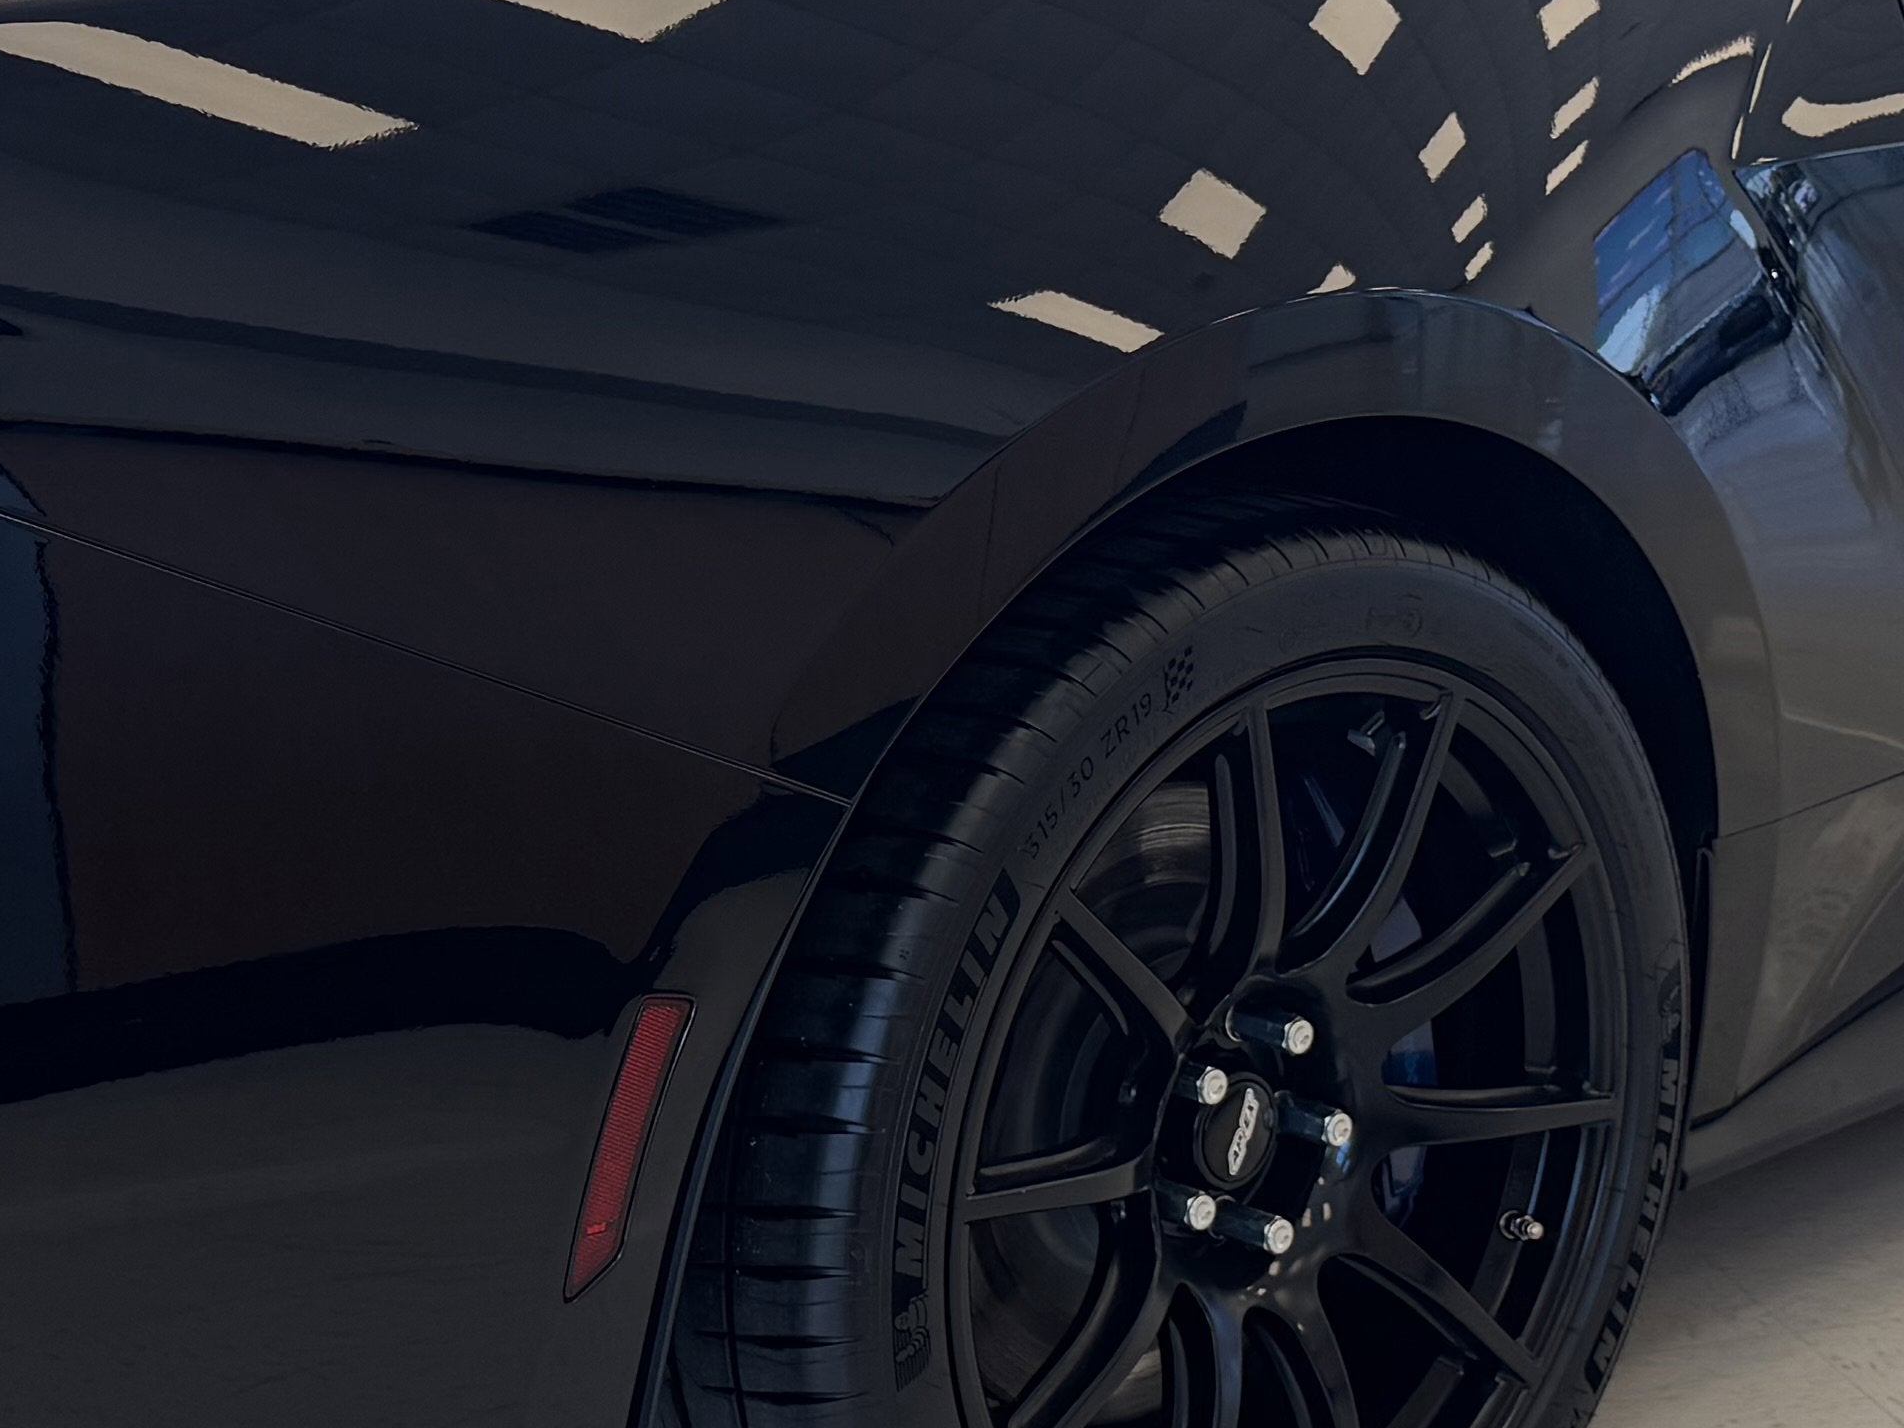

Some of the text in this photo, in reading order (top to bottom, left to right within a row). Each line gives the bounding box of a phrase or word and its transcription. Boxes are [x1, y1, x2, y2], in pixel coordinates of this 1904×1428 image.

[1099, 691, 1153, 760] ZR19
[895, 892, 1010, 1279] MICHELIN
[1592, 1058, 1680, 1376] MICHELIN
